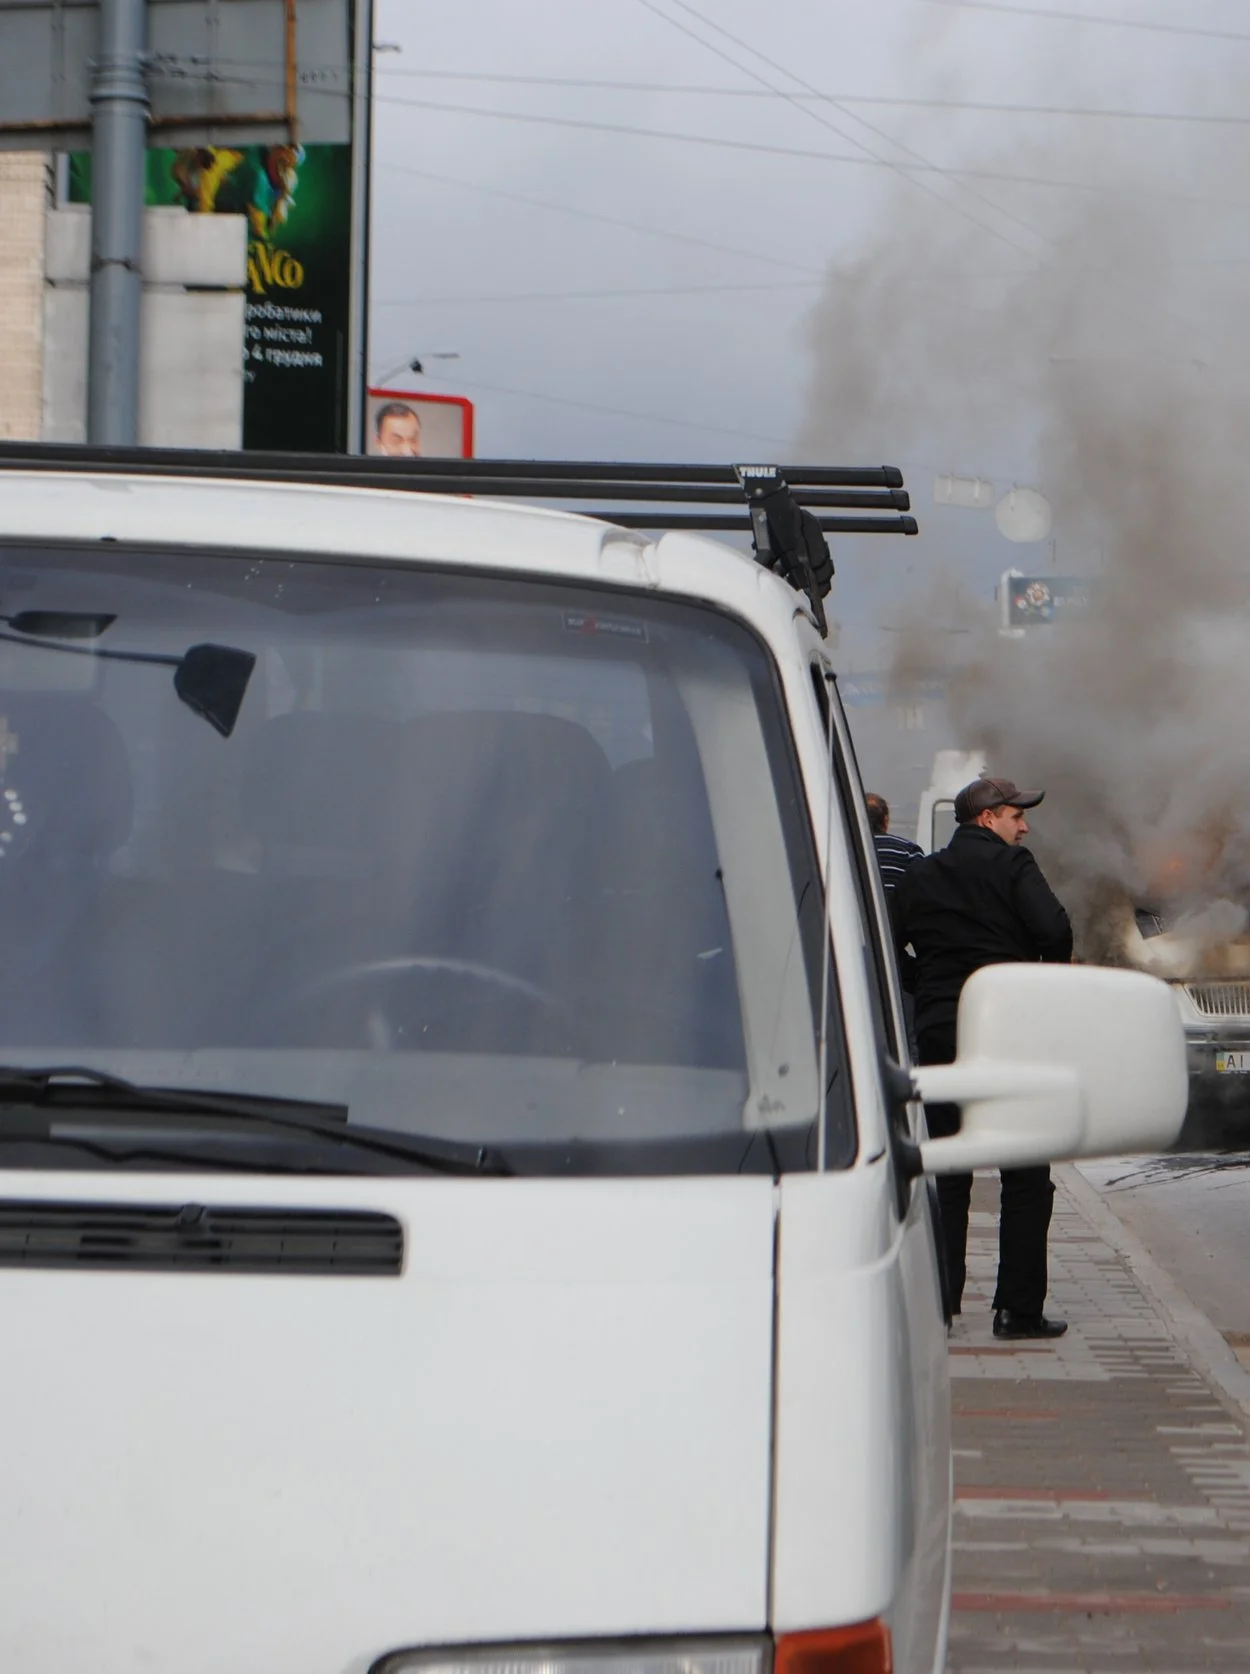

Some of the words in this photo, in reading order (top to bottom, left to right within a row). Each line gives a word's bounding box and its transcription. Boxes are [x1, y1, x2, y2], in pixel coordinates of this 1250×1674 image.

[264, 325, 312, 344] міста!
[265, 348, 323, 367] грудня
[739, 466, 777, 478] THULE
[1226, 1055, 1244, 1068] AI
